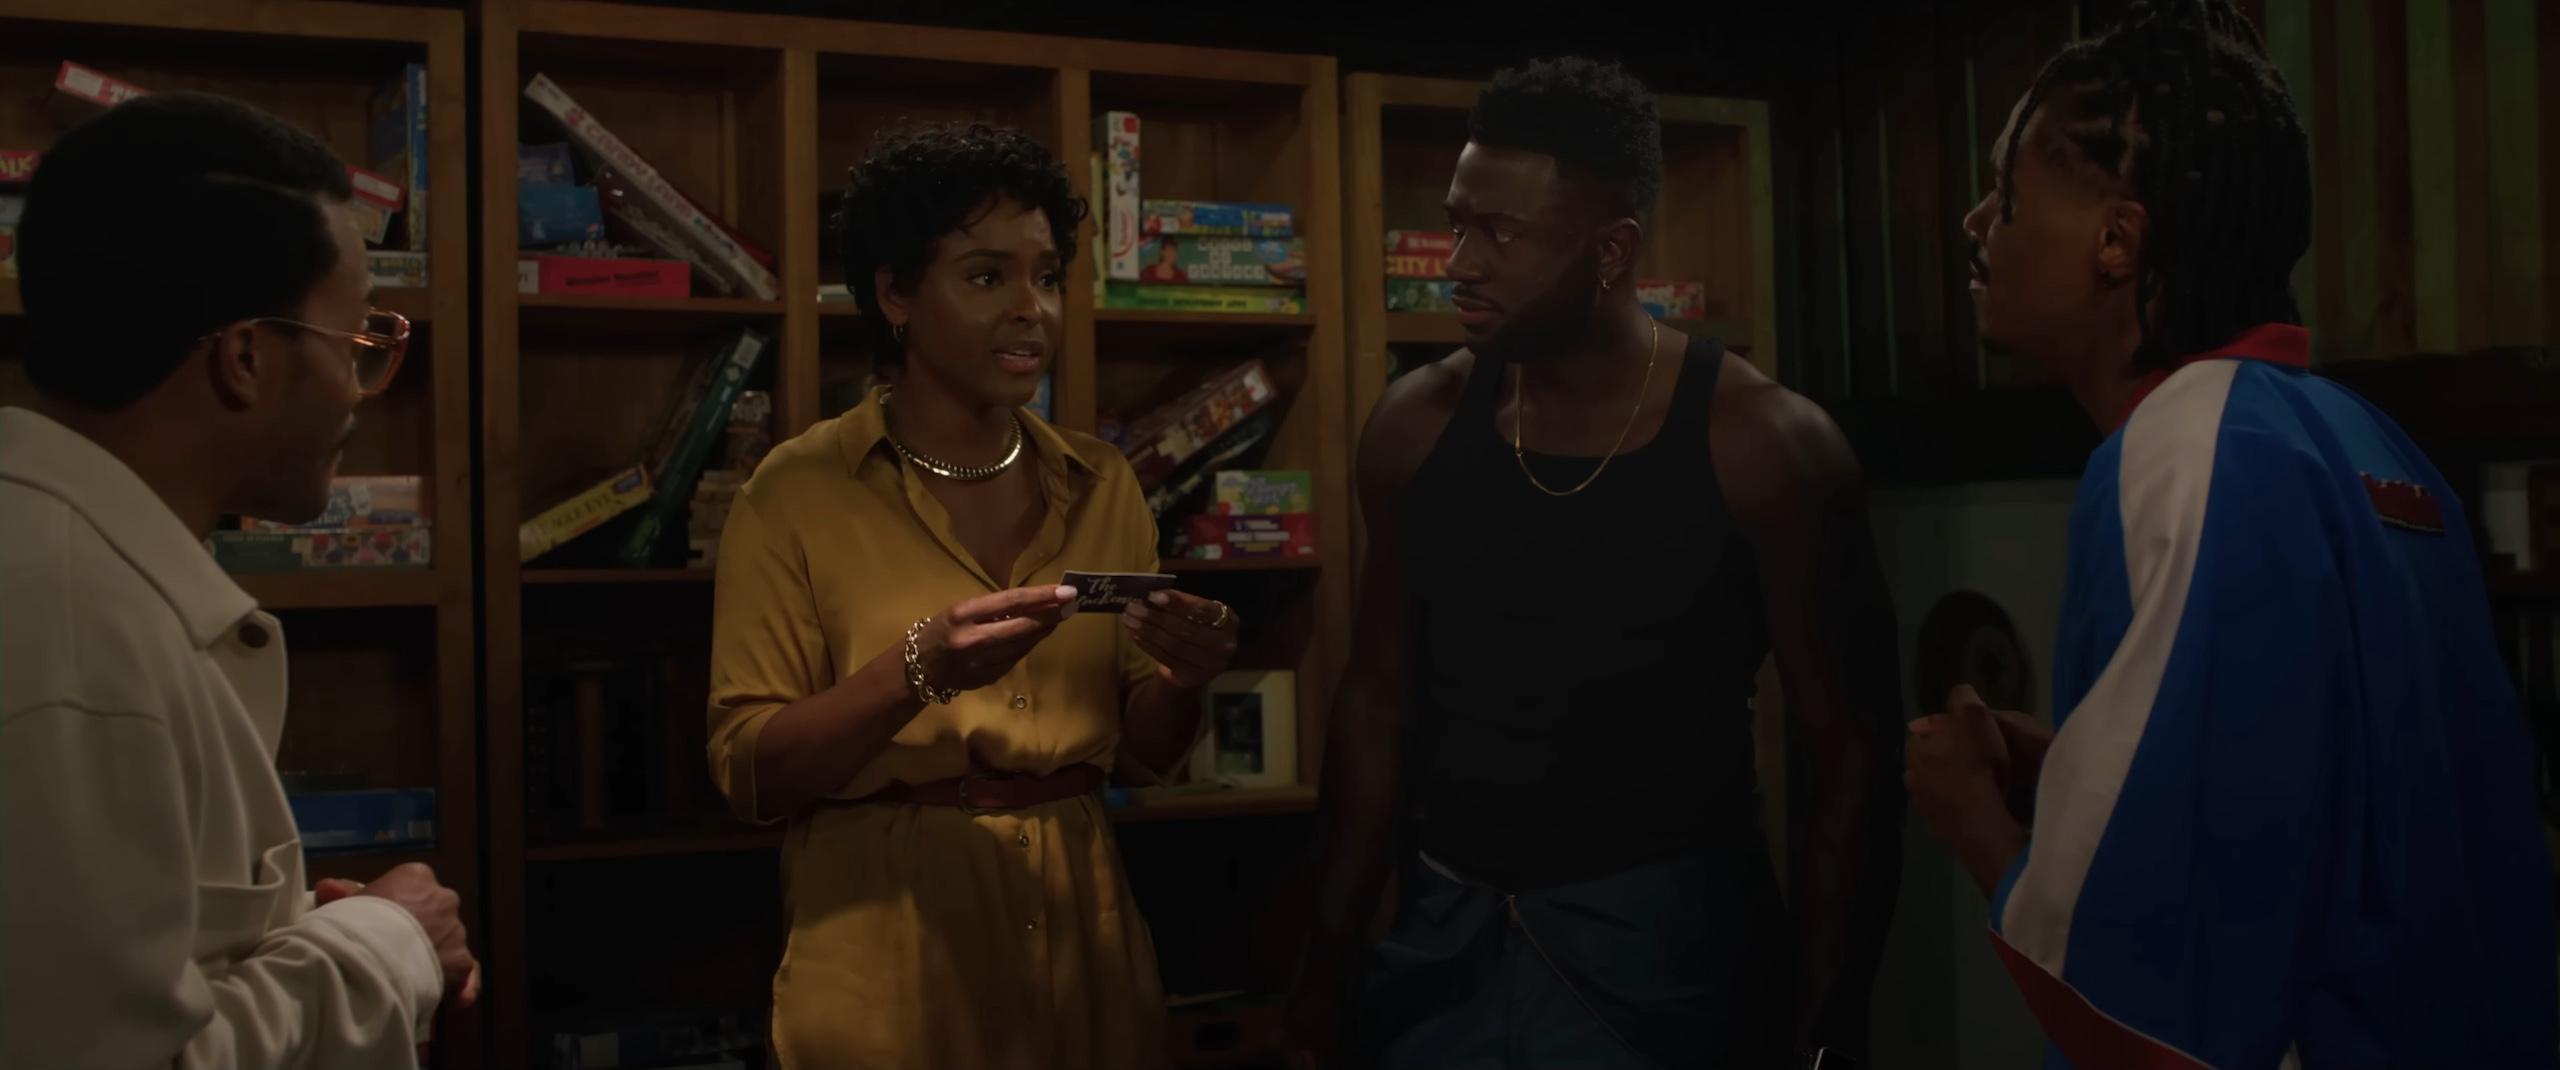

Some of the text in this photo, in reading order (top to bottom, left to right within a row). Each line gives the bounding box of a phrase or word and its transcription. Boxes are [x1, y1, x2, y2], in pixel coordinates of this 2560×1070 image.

[0, 156, 33, 177] ALK
[1386, 256, 1429, 275] CITY
[1088, 576, 1118, 595] The
